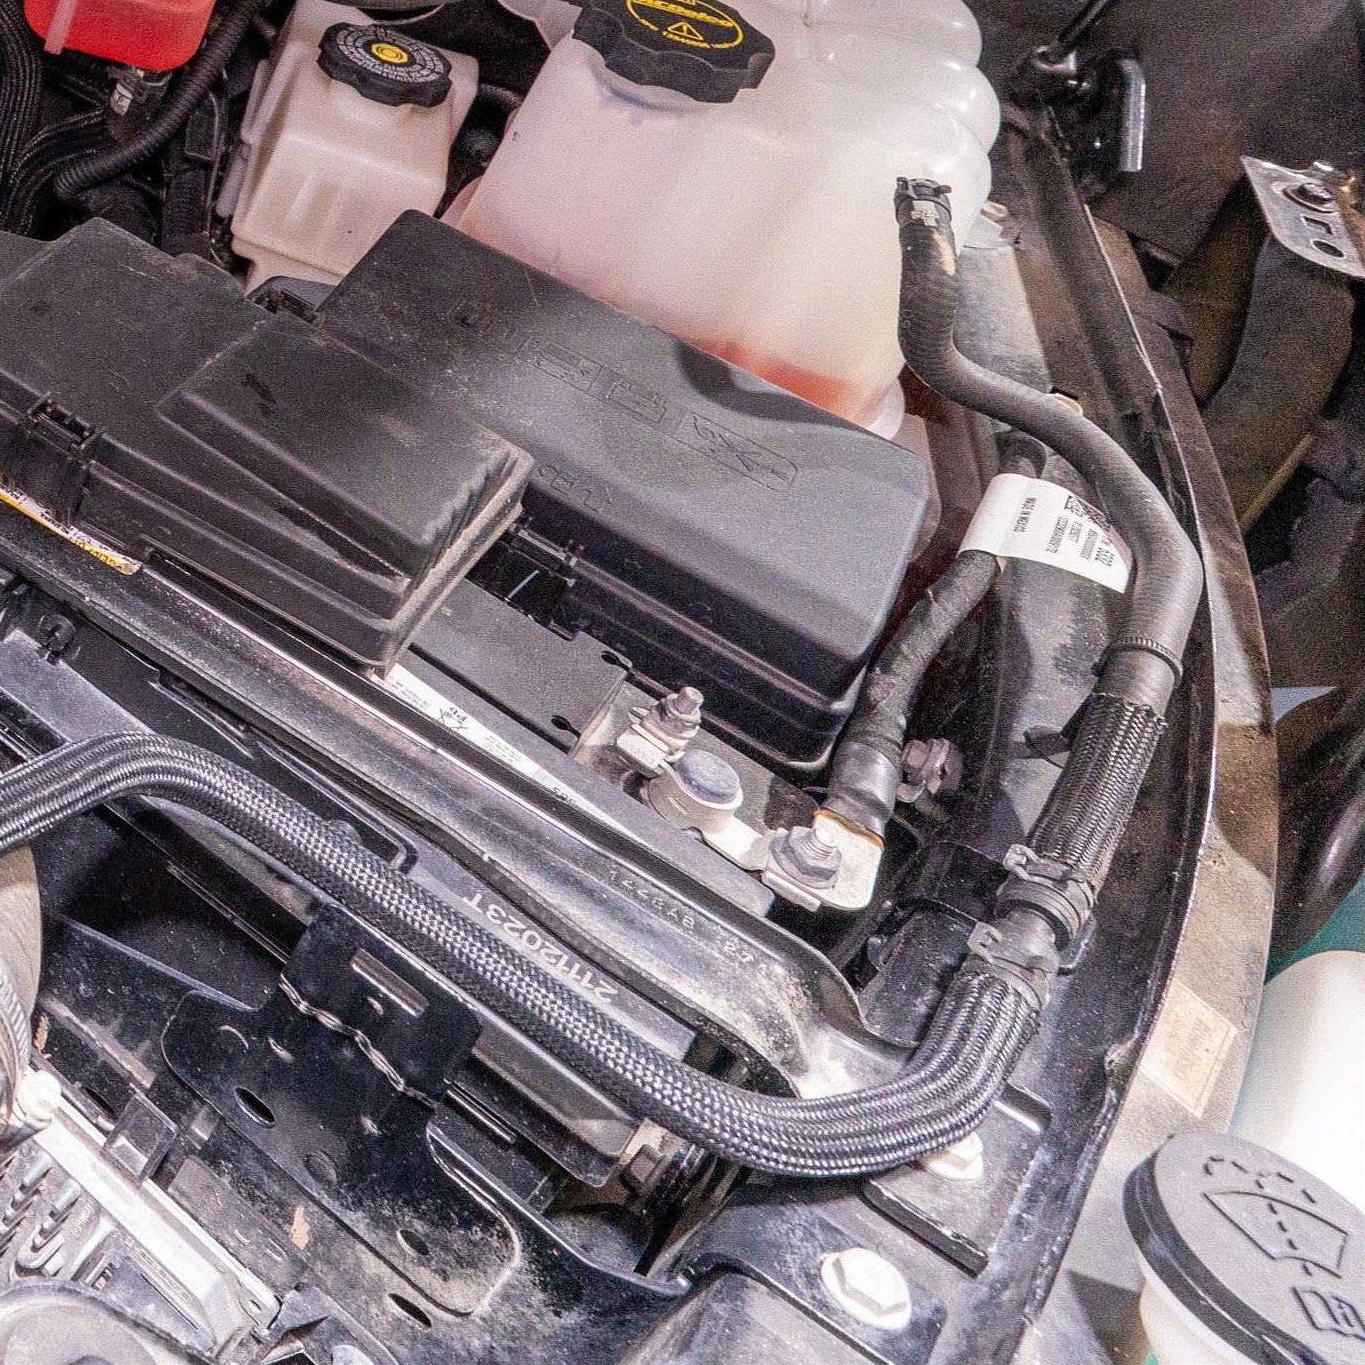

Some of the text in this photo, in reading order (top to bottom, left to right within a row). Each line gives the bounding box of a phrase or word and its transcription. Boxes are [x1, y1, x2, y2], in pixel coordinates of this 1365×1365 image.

[1021, 496, 1038, 511] MADE
[1012, 515, 1031, 534] MEXICO
[447, 705, 468, 722] Pb
[461, 891, 619, 1004] 21112023T
